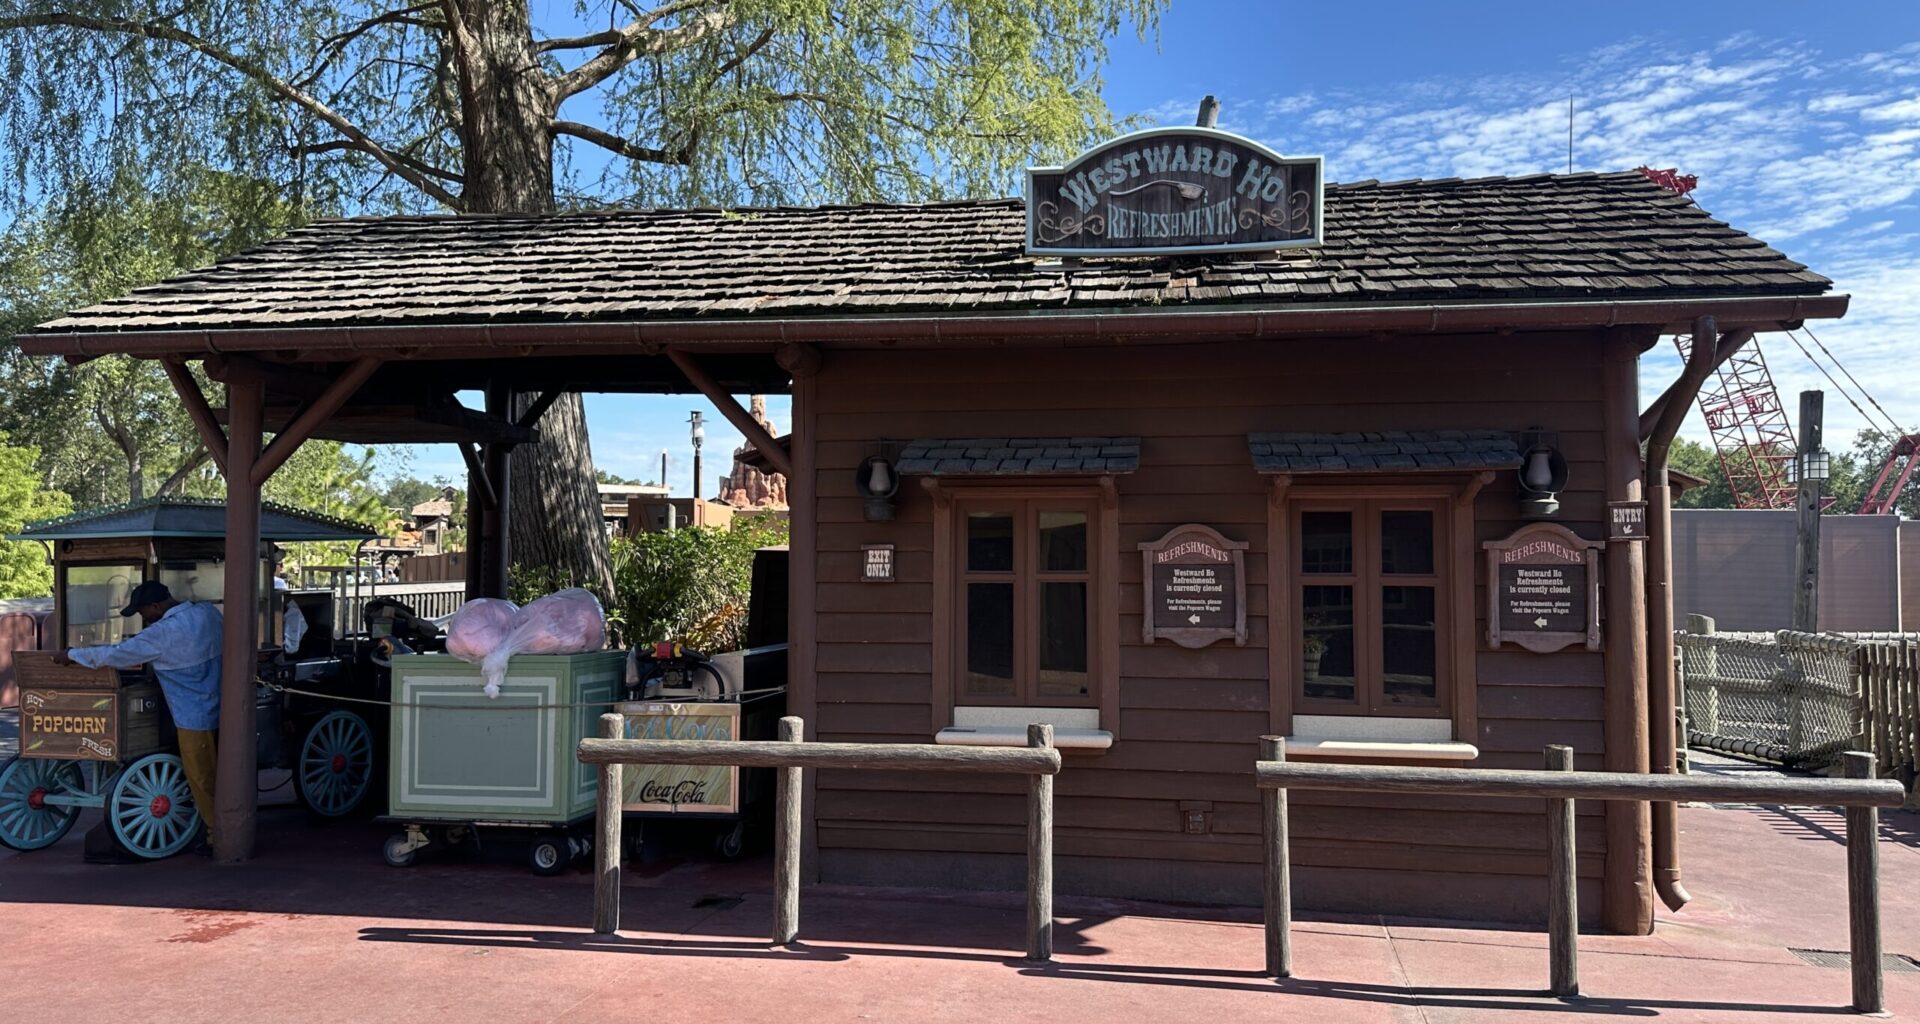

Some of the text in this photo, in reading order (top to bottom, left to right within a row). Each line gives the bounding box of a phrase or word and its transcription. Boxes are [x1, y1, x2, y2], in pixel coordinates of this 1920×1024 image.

[1059, 144, 1284, 214] WESTWARD HO
[1106, 198, 1237, 239] REFRESHMENTS
[1613, 508, 1642, 523] ENTRY
[868, 550, 890, 563] EXIT
[1158, 541, 1228, 563] REFRESHMENTS
[1504, 541, 1581, 563] REFRESHMENTS
[866, 563, 890, 577] ONLY
[1173, 569, 1215, 577] Westward Ho
[1518, 569, 1562, 577] Westward Ho
[1172, 576, 1216, 584] Refreshments
[1517, 577, 1564, 585] Refreshments
[1166, 584, 1222, 593] is currently closed
[1517, 586, 1549, 595] currently
[26, 694, 45, 707] HOT
[32, 715, 106, 734] POPCORN
[81, 737, 112, 757] FRESH
[640, 780, 707, 803] Coca-Cola
